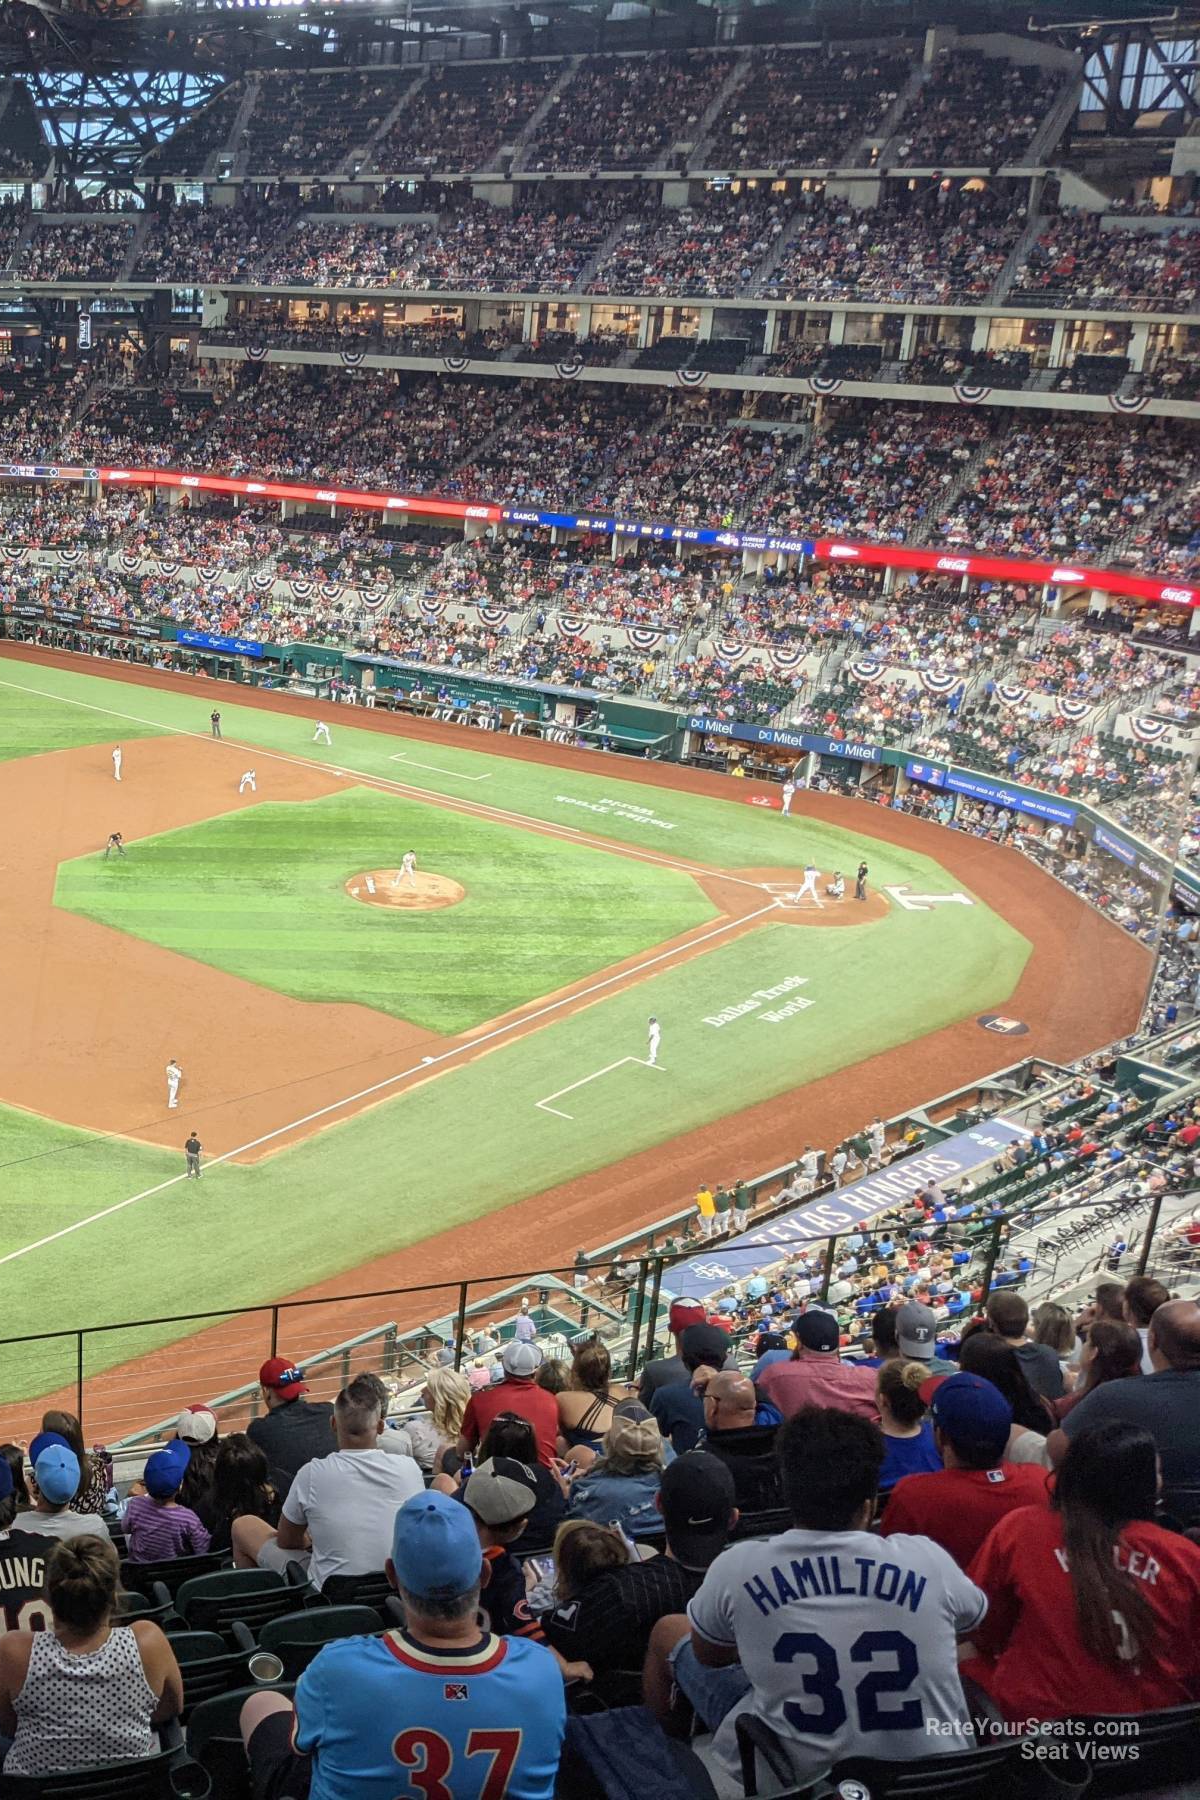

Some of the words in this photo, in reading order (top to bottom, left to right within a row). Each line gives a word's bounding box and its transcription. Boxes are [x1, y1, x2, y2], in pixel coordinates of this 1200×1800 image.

[769, 539, 802, 551] $14405
[705, 718, 734, 735] Mitel
[773, 732, 803, 747] Mitel
[844, 743, 876, 760] Mitel
[702, 999, 761, 1028] Dallas
[752, 975, 809, 1001] Truck
[756, 997, 816, 1024] World
[749, 1204, 853, 1255] TEXAS
[837, 1152, 962, 1213] RANGERS
[743, 1556, 927, 1617] HAMILTON
[773, 1630, 925, 1735] 32
[392, 1726, 523, 1800] 37
